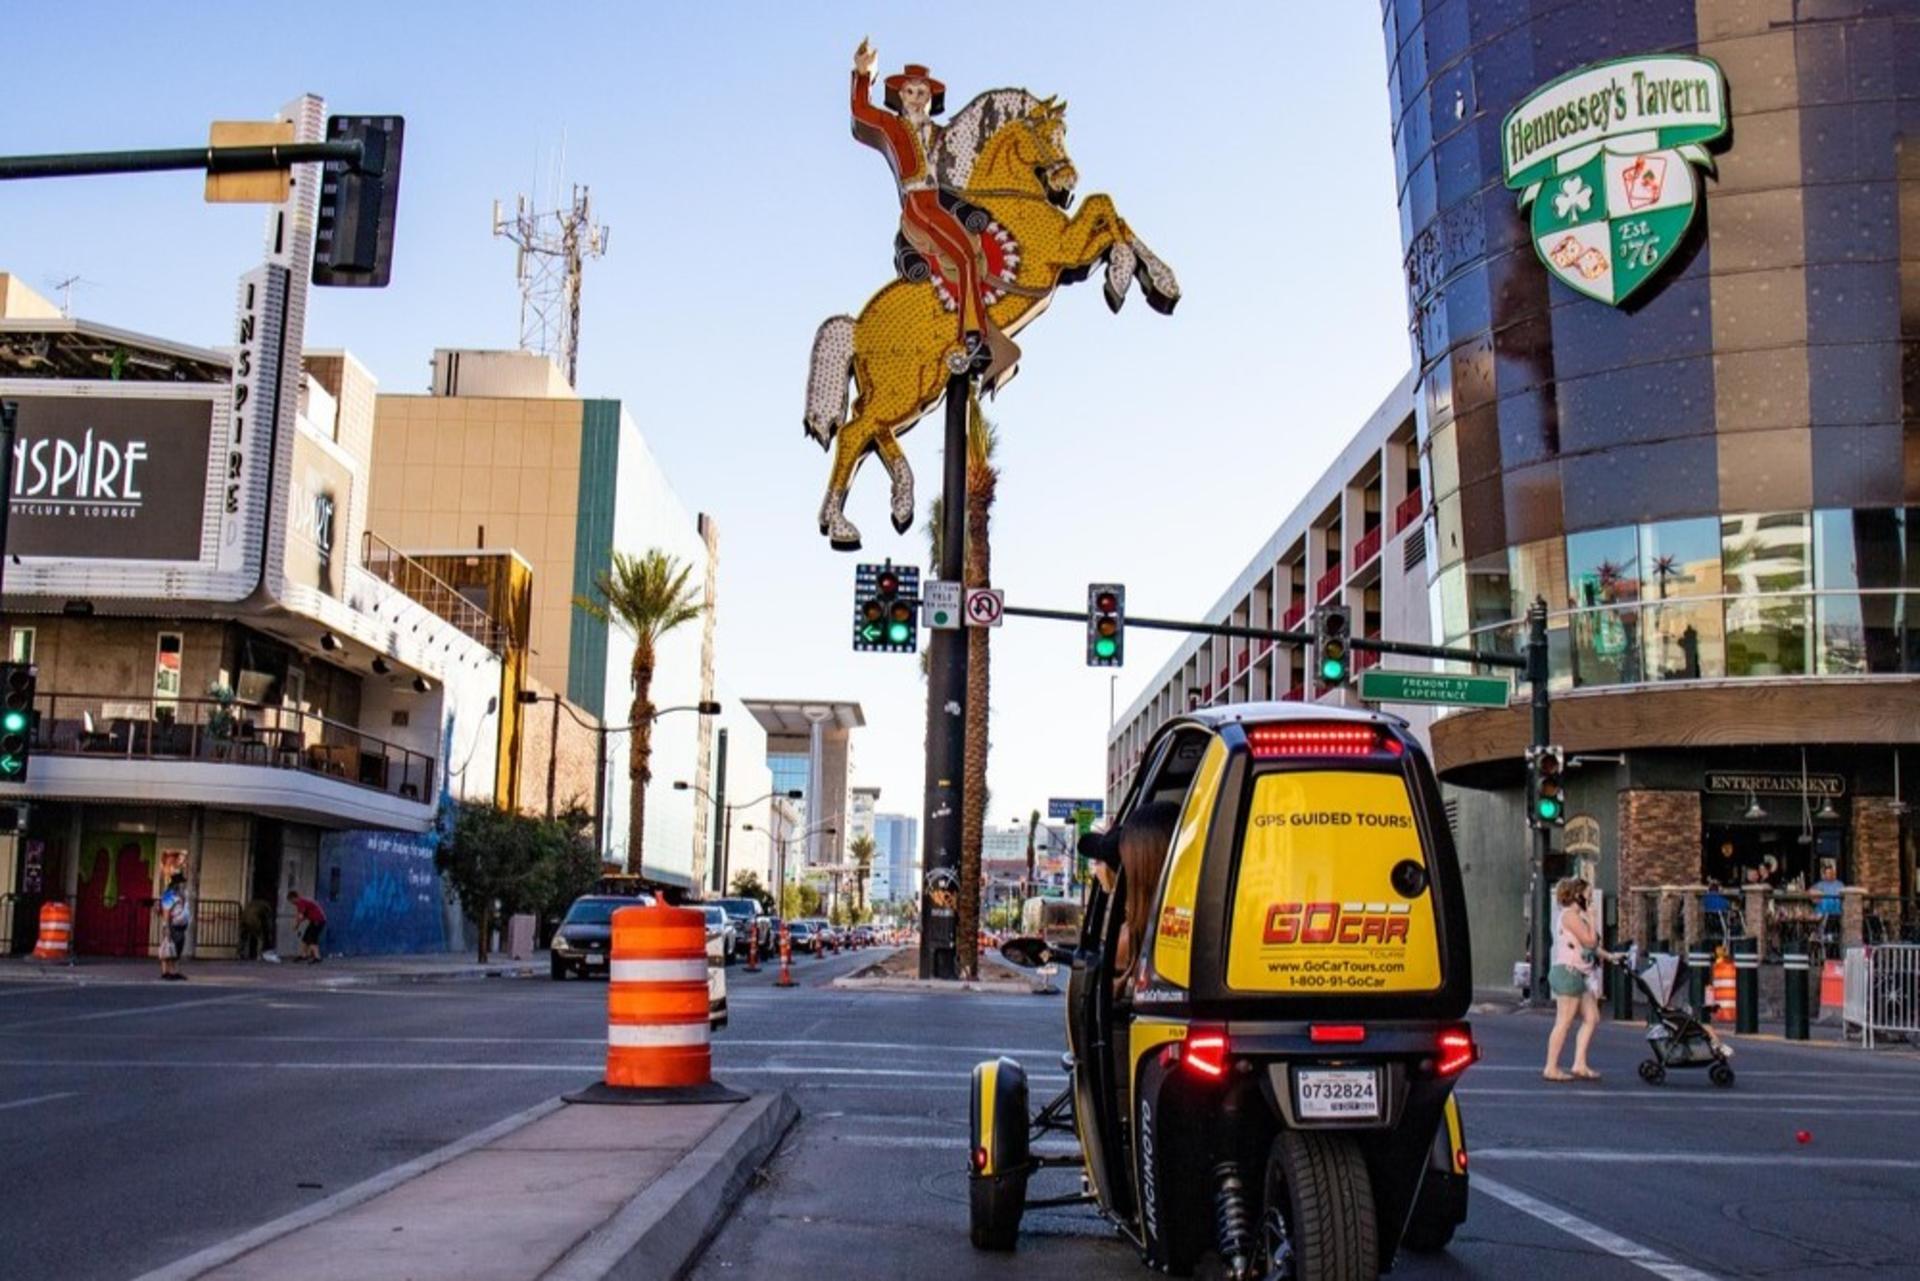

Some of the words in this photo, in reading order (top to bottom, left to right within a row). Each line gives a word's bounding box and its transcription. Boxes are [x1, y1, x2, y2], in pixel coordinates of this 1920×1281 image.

[1510, 77, 1628, 165] Hennessey's
[1631, 71, 1712, 118] Tavern
[13, 427, 147, 499] NSPIRE
[84, 507, 136, 518] LOUNGE
[1402, 677, 1449, 689] FREMONT
[1456, 680, 1468, 690] ST
[1402, 688, 1467, 700] EXPERIENCE
[1711, 775, 1839, 792] ENTERTAINMENT
[1254, 814, 1286, 827] GPS
[1290, 812, 1352, 826] GUIDED
[1356, 812, 1413, 829] TOURS!
[1268, 960, 1405, 972] www.GoCarTours.com
[1290, 975, 1386, 988] 1-800-91-GoCar
[1303, 1083, 1374, 1099] 0732824
[1142, 1099, 1158, 1240] ARGIMOTO
